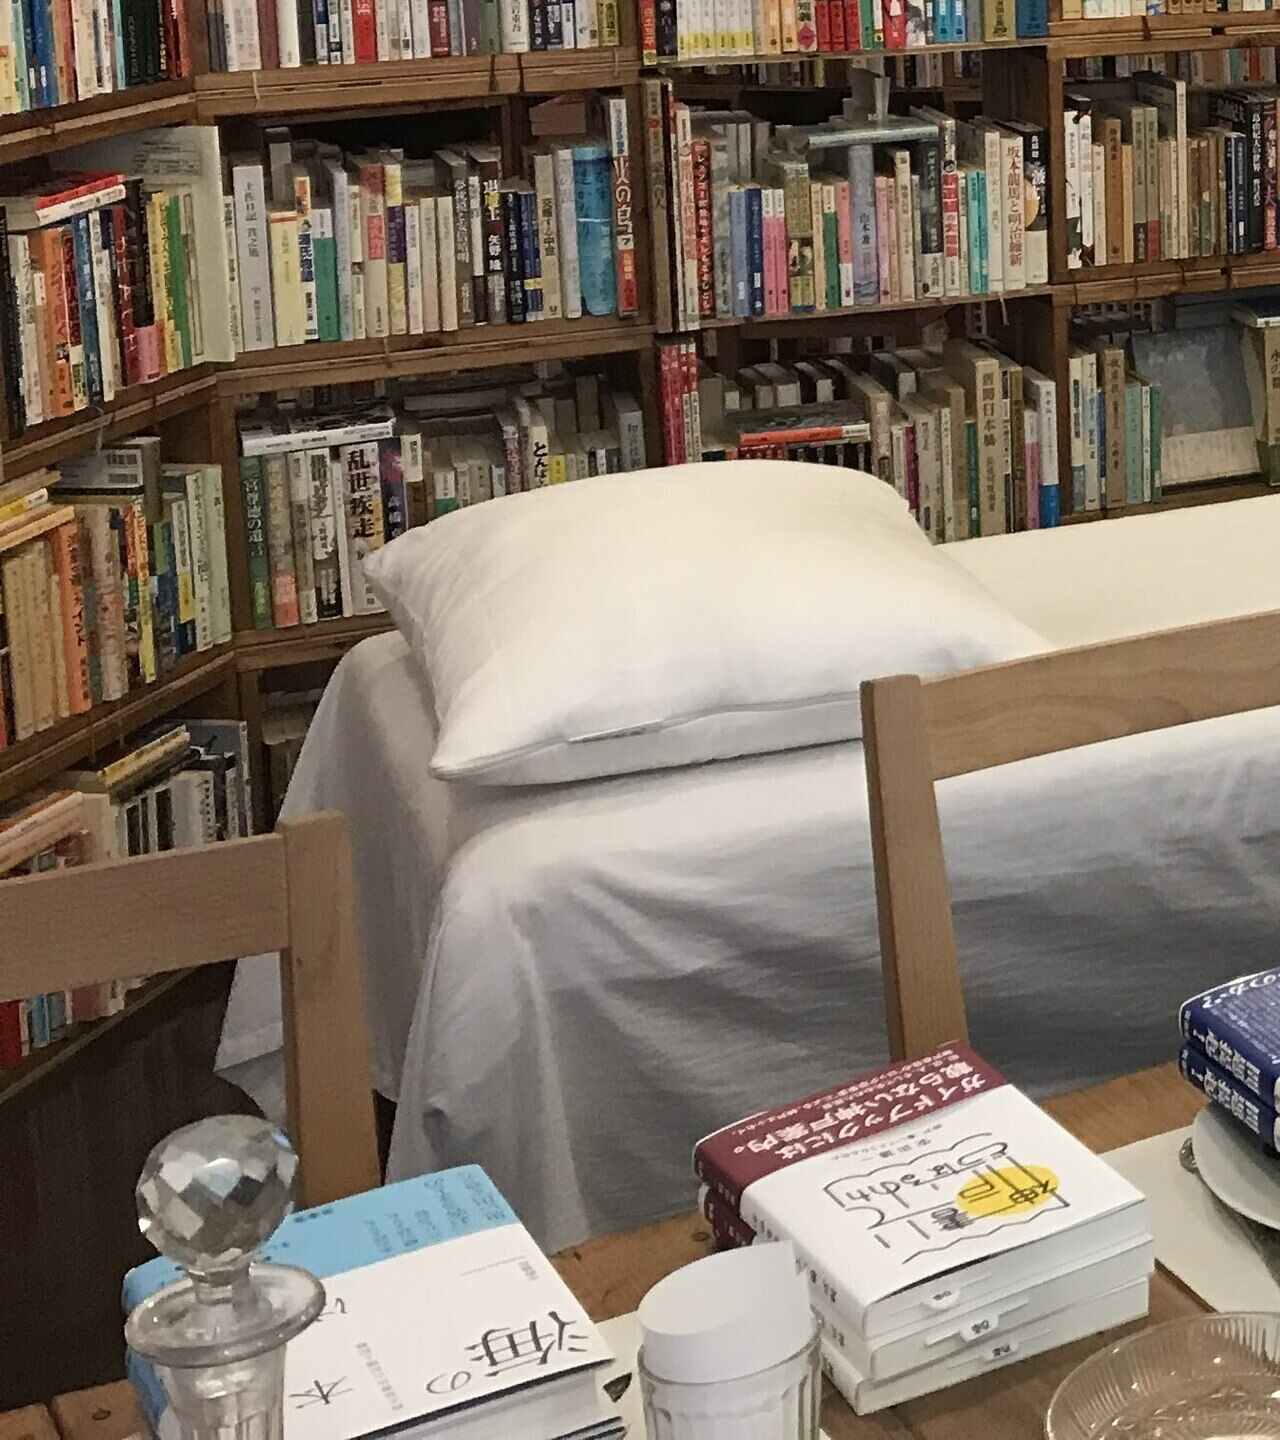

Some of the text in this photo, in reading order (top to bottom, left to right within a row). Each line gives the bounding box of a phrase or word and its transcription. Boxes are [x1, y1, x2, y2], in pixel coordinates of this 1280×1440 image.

[347, 449, 375, 538] 乱世疾走
[774, 1073, 988, 1162] ガイドブックには
[289, 1370, 354, 1410] 本
